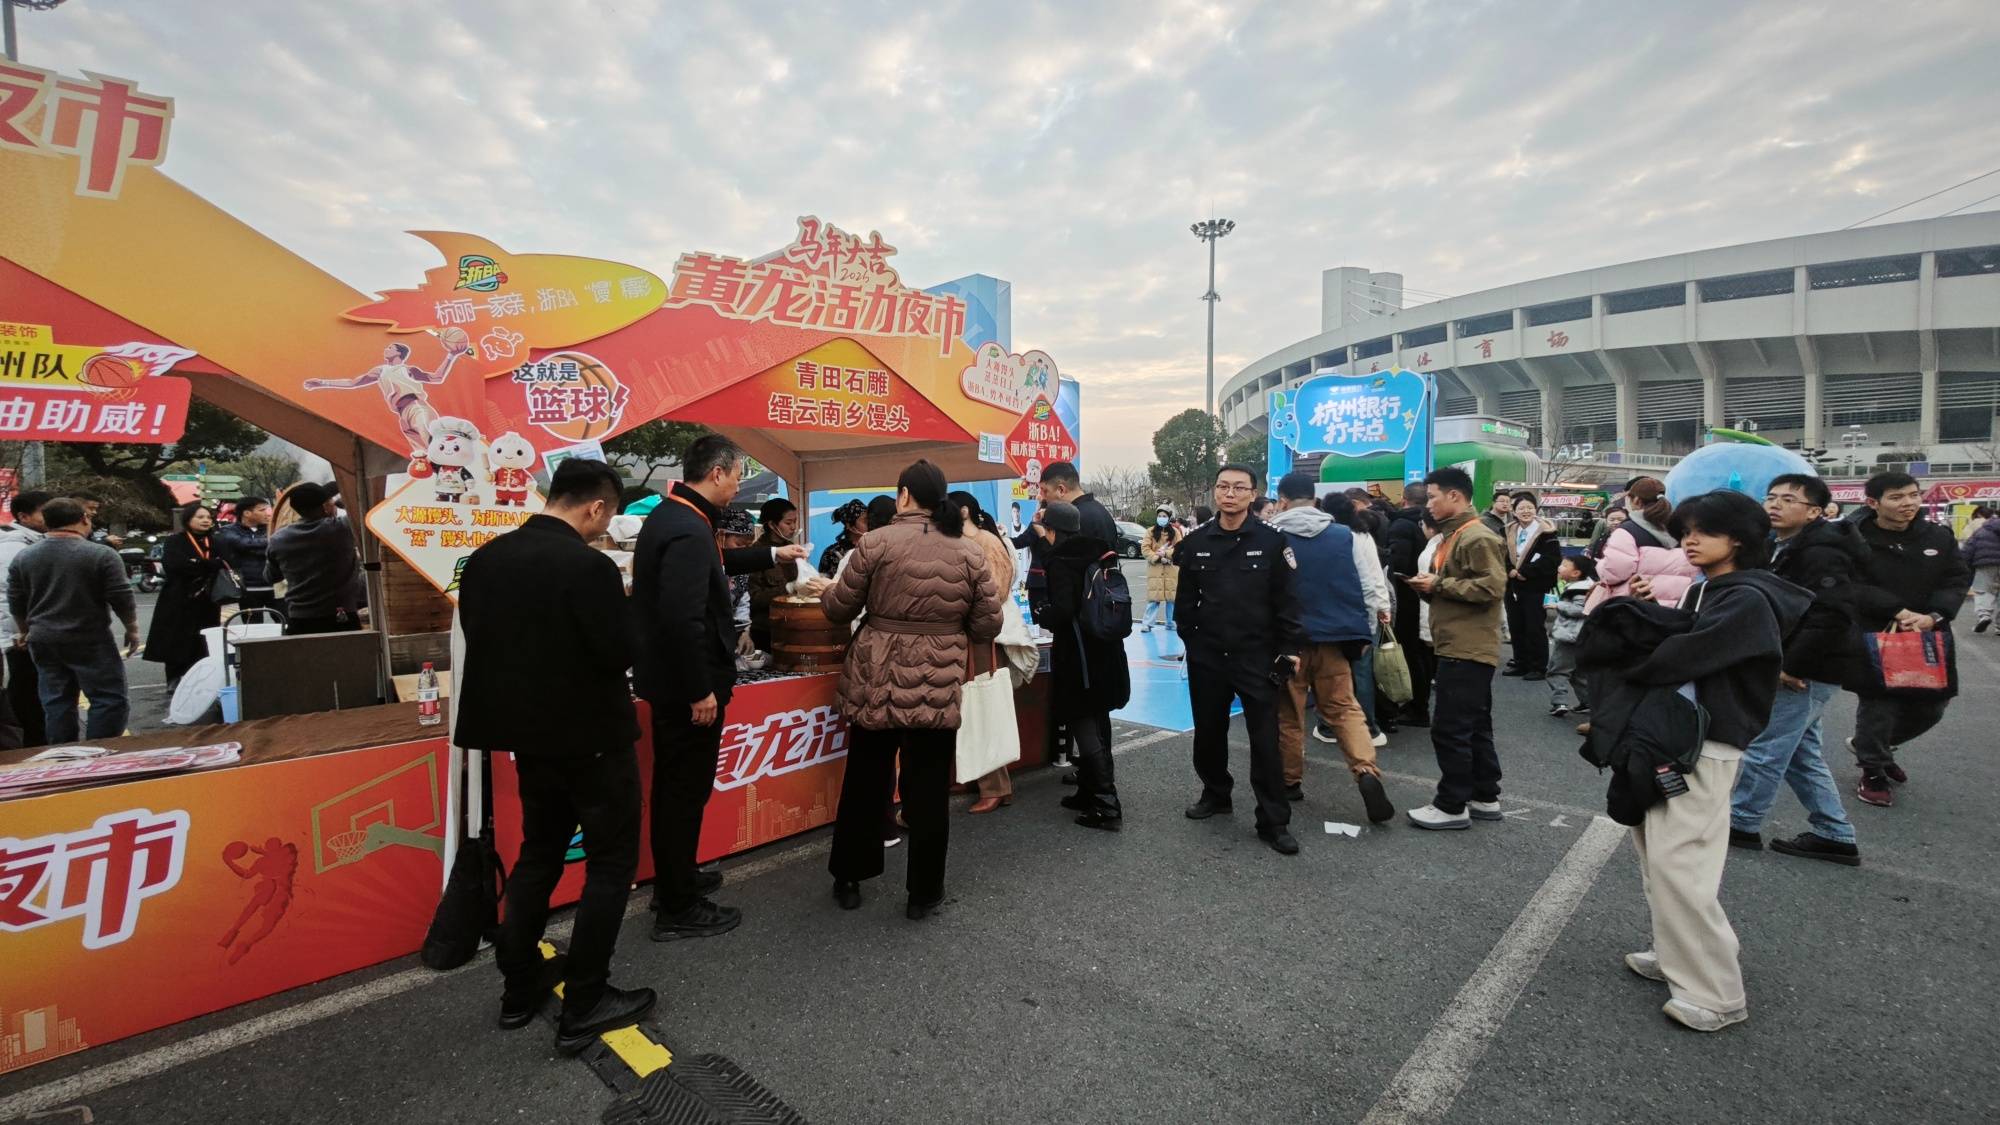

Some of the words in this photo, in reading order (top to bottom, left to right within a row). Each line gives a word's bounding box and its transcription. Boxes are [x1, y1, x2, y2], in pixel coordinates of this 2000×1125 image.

[789, 218, 897, 288] 马年大吉
[668, 253, 966, 356] 黄龙活力夜市
[513, 362, 579, 382] 这就是
[795, 360, 889, 397] 青田石雕
[768, 392, 911, 432] 缙云南乡馒头
[1308, 395, 1401, 427] 杭州银行
[1028, 421, 1061, 442] 浙BA!
[1322, 418, 1385, 445] 打卡点
